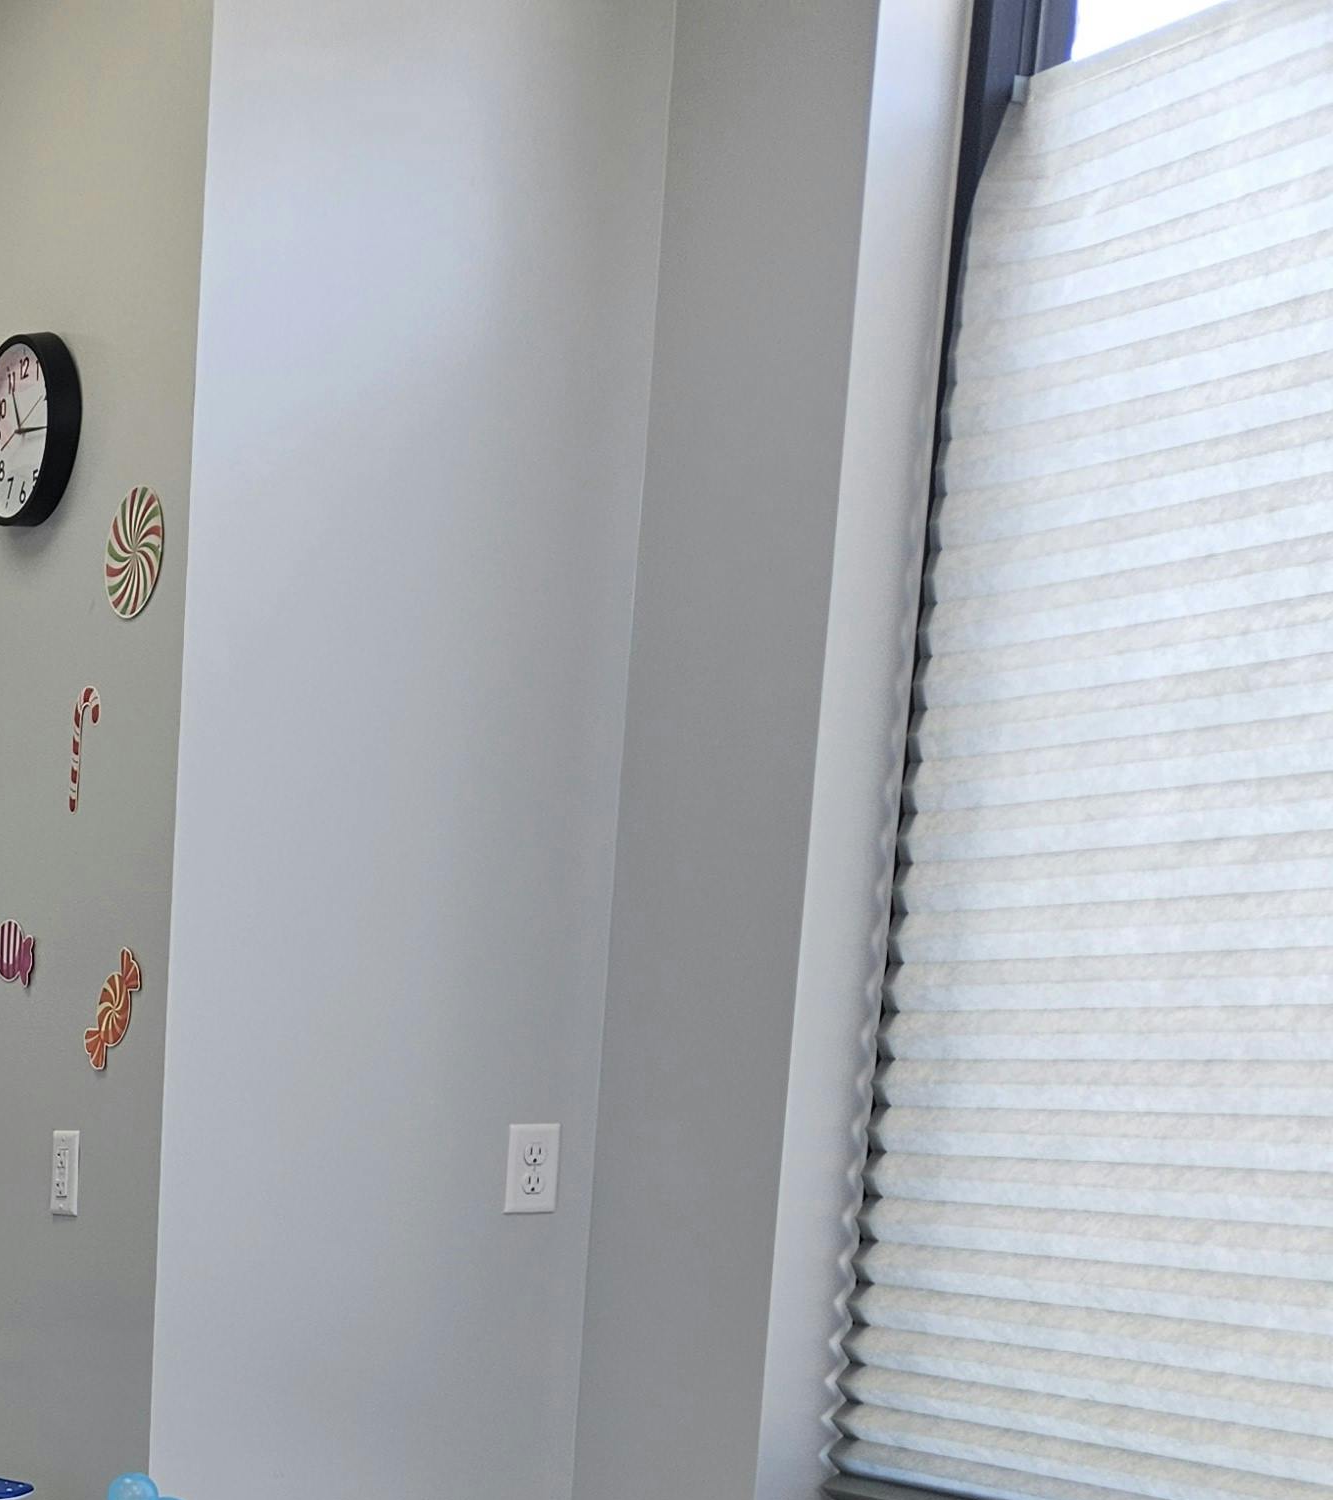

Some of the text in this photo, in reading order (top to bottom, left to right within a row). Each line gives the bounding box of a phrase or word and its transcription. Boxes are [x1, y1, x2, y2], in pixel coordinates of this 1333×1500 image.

[19, 356, 30, 380] 12
[7, 370, 16, 395] 11
[7, 476, 14, 500] 7
[19, 481, 27, 505] 6
